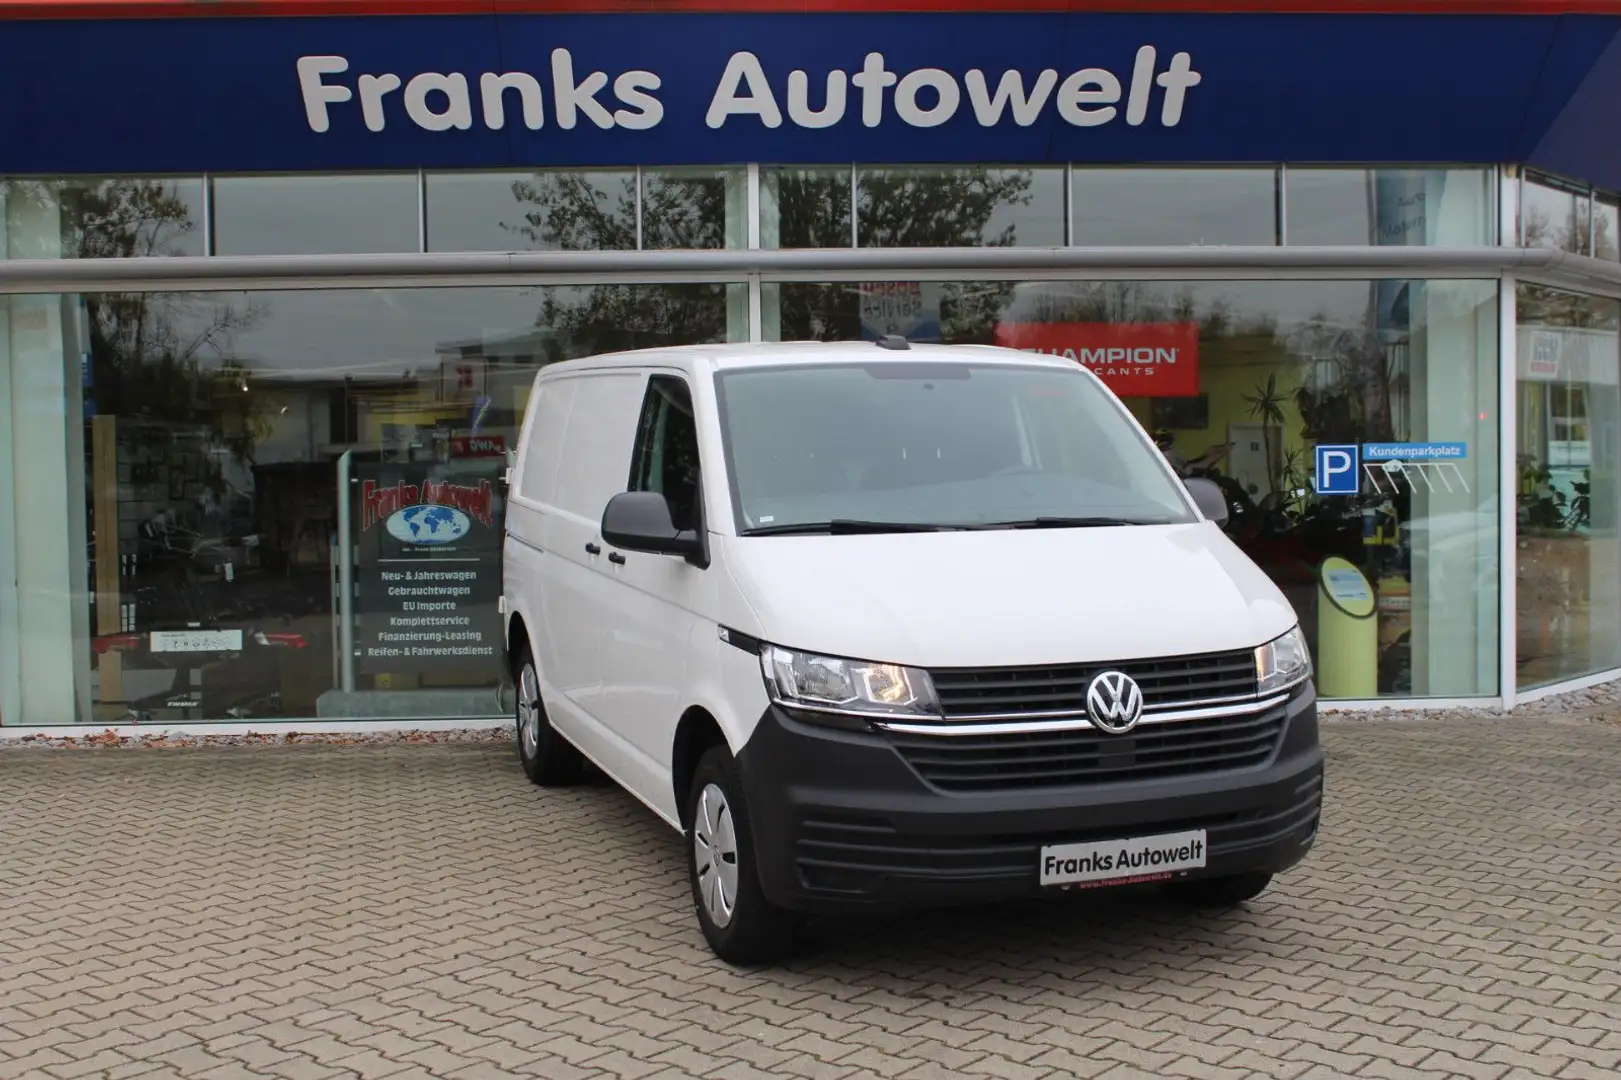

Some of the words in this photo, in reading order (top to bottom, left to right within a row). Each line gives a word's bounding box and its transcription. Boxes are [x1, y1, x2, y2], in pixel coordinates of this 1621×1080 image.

[296, 48, 664, 132] Franks
[706, 45, 1202, 129] Autowelt
[1020, 348, 1177, 364] AMPION
[1094, 367, 1154, 376] CANTS
[1369, 446, 1461, 458] Kundenparkplatz
[1323, 451, 1351, 488] P
[381, 571, 404, 581] Neu-
[405, 571, 412, 581] &
[412, 570, 477, 581] Jahreswagen
[388, 586, 470, 597] Gebrauchtwagen
[403, 602, 416, 611] EU
[416, 601, 456, 612] Importe
[390, 616, 470, 627] Komplettservice
[378, 631, 482, 642] Finanzierung-Leasing
[368, 646, 402, 657] Reifen-
[403, 646, 411, 656] &
[411, 645, 493, 657] Fahrwerksdienst
[1044, 851, 1113, 876] Franks
[1116, 840, 1203, 870] Autowelt
